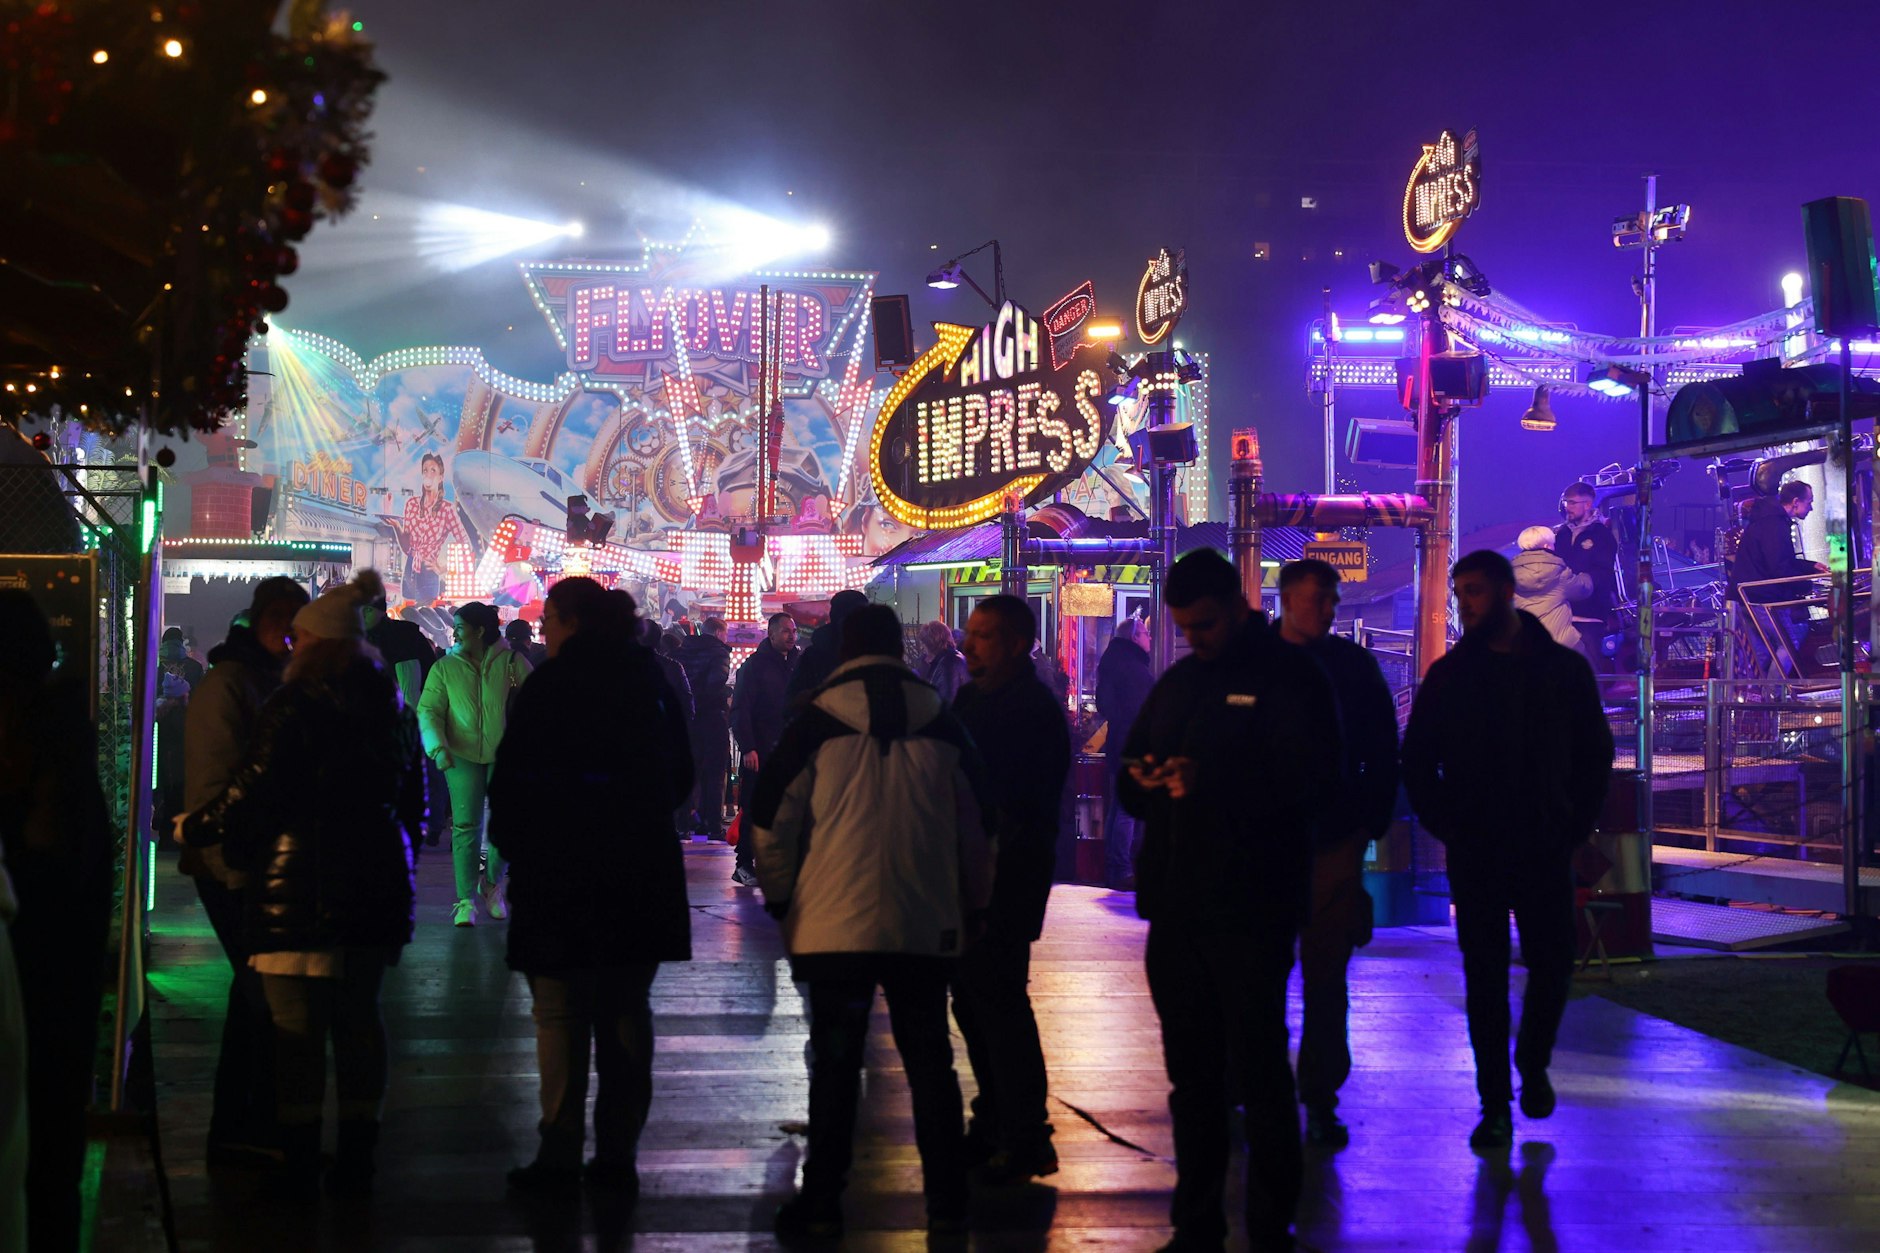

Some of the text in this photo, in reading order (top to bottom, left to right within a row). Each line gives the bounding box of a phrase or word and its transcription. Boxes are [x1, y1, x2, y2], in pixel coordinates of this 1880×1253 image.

[1415, 164, 1473, 226] IMPRESS
[1052, 299, 1088, 332] DANGER
[1144, 275, 1183, 324] IMPRESS
[960, 299, 1039, 387] HIGH
[916, 368, 1102, 484] IMPRESS
[293, 460, 367, 508] DINER
[1307, 552, 1362, 566] EINGANG
